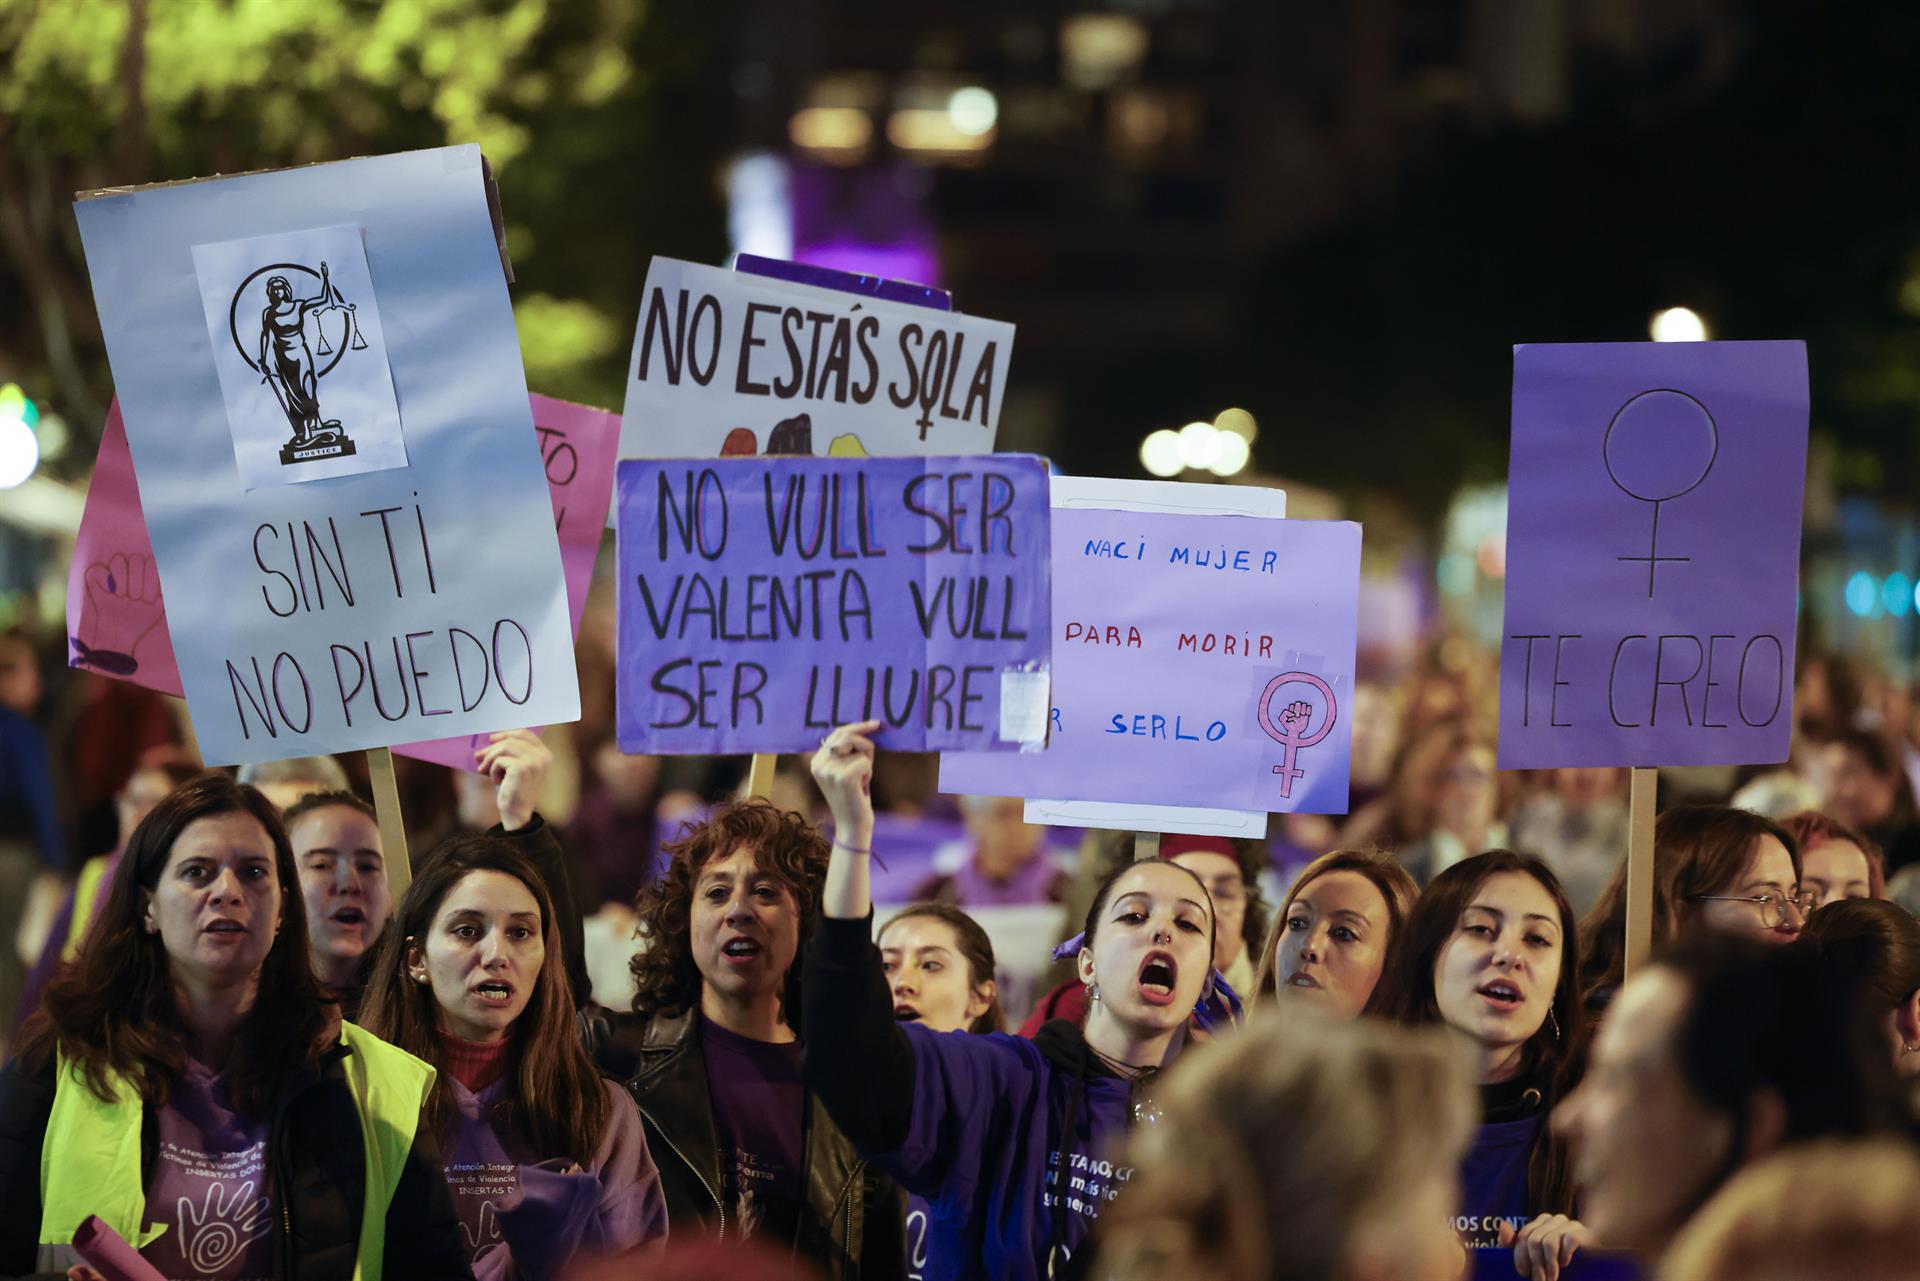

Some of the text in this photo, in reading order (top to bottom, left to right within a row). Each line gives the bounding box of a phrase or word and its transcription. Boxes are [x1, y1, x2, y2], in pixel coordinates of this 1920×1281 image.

[638, 286, 997, 440] NO ESTÁS SOLA
[298, 447, 338, 456] JUSTICE
[658, 468, 1016, 561] NO VULL SER
[252, 517, 355, 618] SIN
[637, 568, 1027, 642] VALENTA VULL
[1065, 622, 1143, 649] PARA
[226, 618, 534, 740] NO PUEDO
[649, 657, 994, 732] SER LLIURE
[1511, 634, 1784, 729] TE CREO
[1105, 713, 1227, 743] SERLO
[453, 1162, 485, 1171] Atención
[458, 1186, 505, 1194] INSERTAS
[467, 1174, 476, 1182] de
